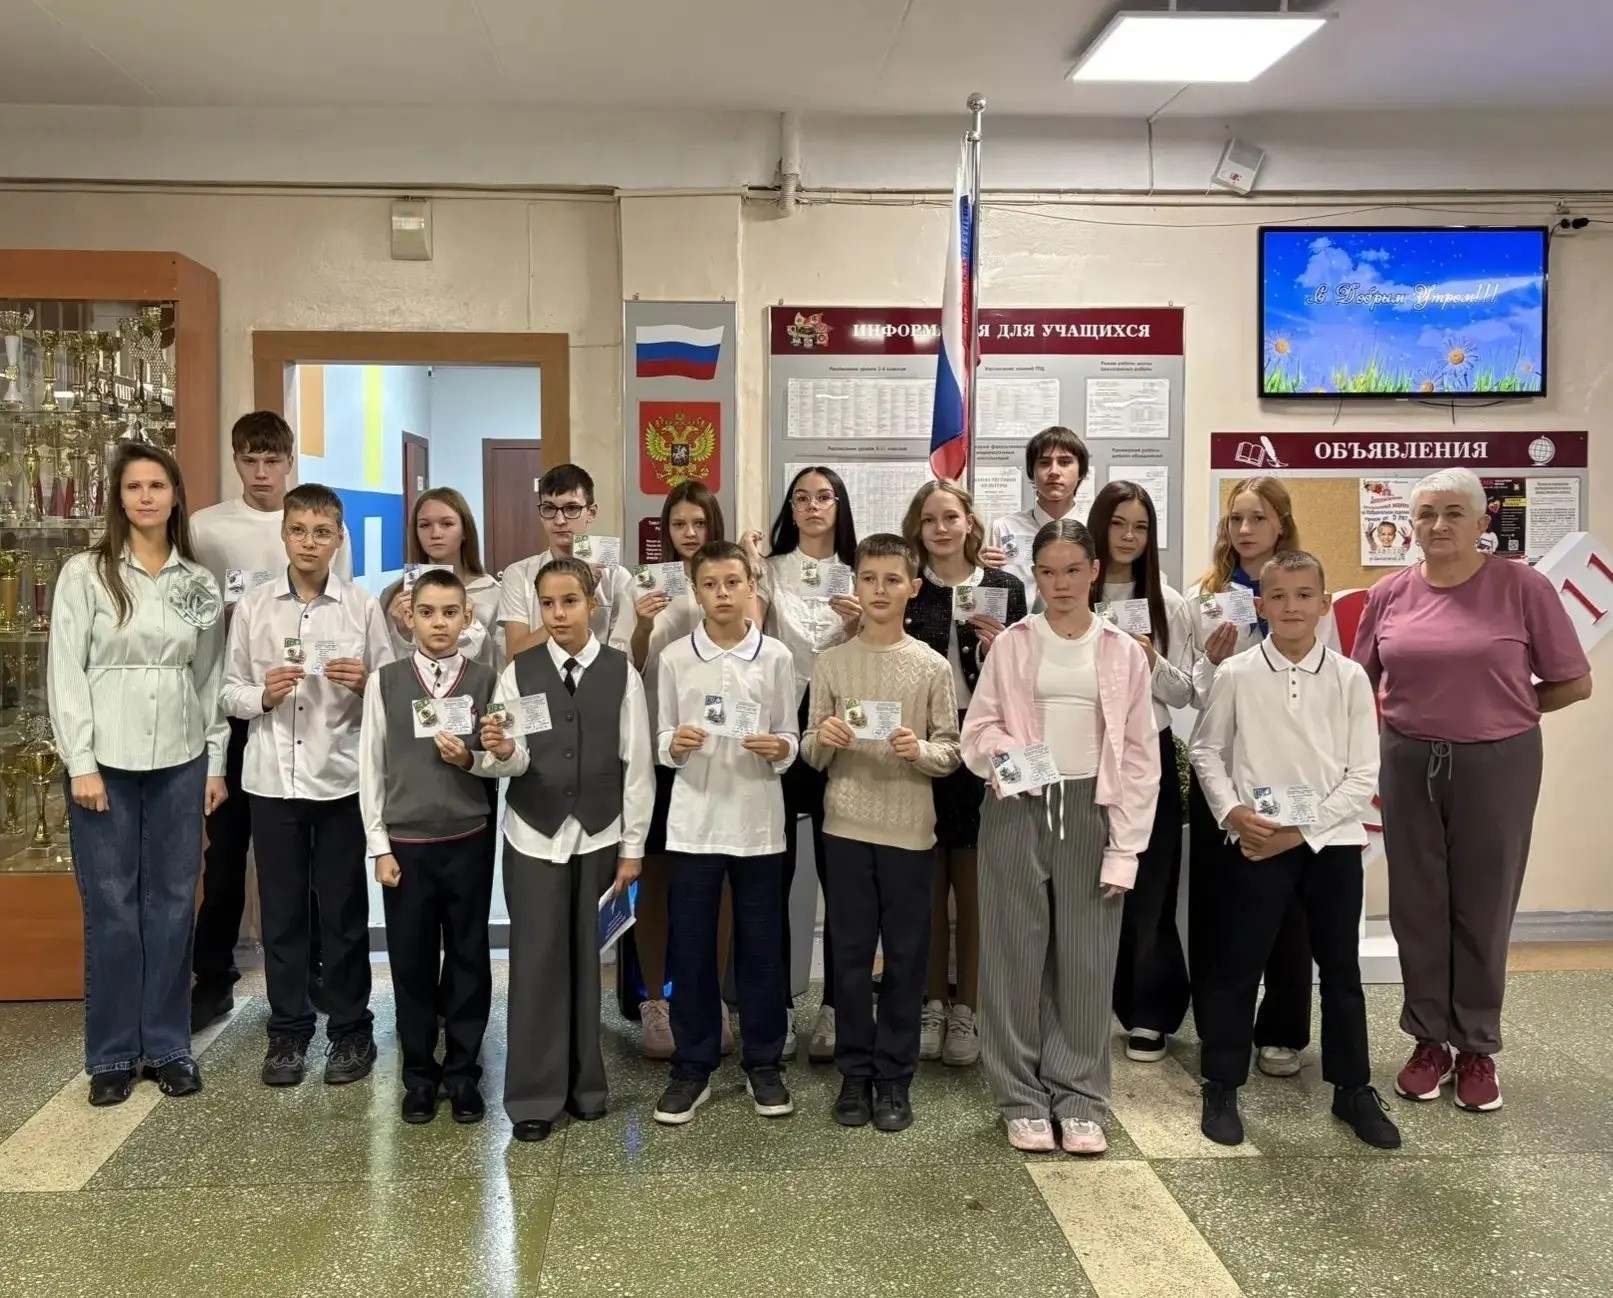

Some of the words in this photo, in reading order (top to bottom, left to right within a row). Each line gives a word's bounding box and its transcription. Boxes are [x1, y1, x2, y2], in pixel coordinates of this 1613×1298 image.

[852, 323, 990, 338] ИНФОРМЯ
[997, 324, 1035, 340] ДЛЯ
[1042, 323, 1151, 341] УЧАЩИХСЯ
[1314, 441, 1489, 460] ОБЪЯВЛЕНИЯ
